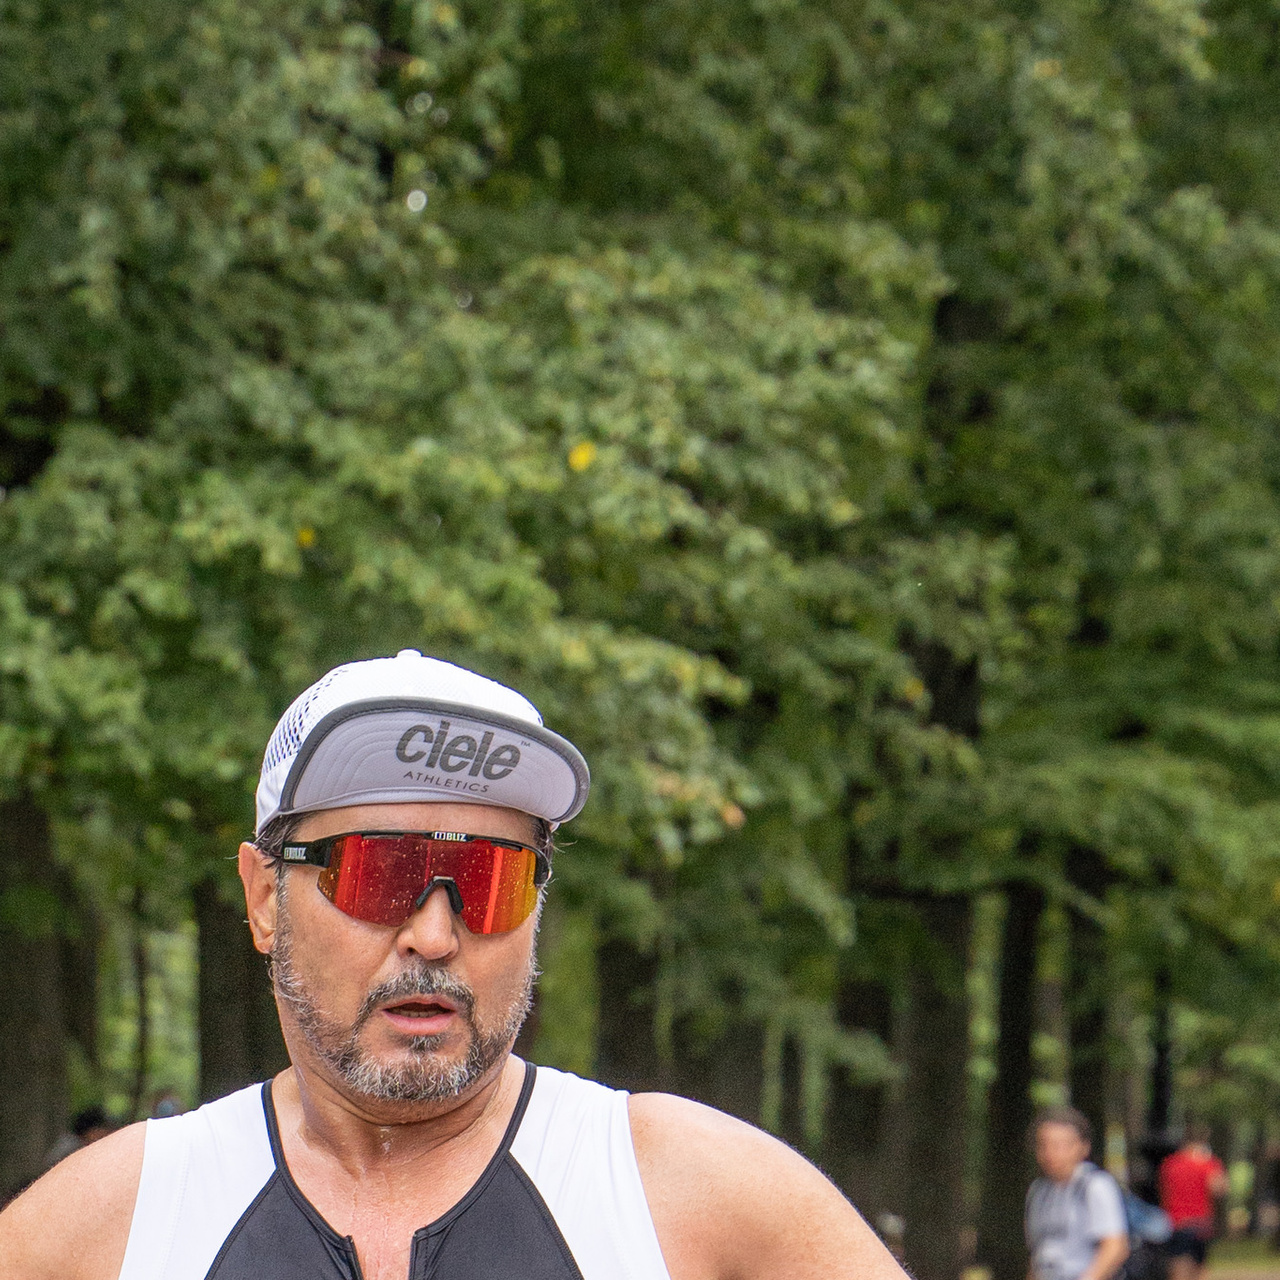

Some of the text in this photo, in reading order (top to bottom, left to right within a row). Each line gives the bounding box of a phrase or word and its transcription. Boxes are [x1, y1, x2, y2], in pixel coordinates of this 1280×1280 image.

[396, 720, 521, 780] ciele
[403, 770, 490, 793] ATHLETICS
[446, 832, 468, 843] BLIZ
